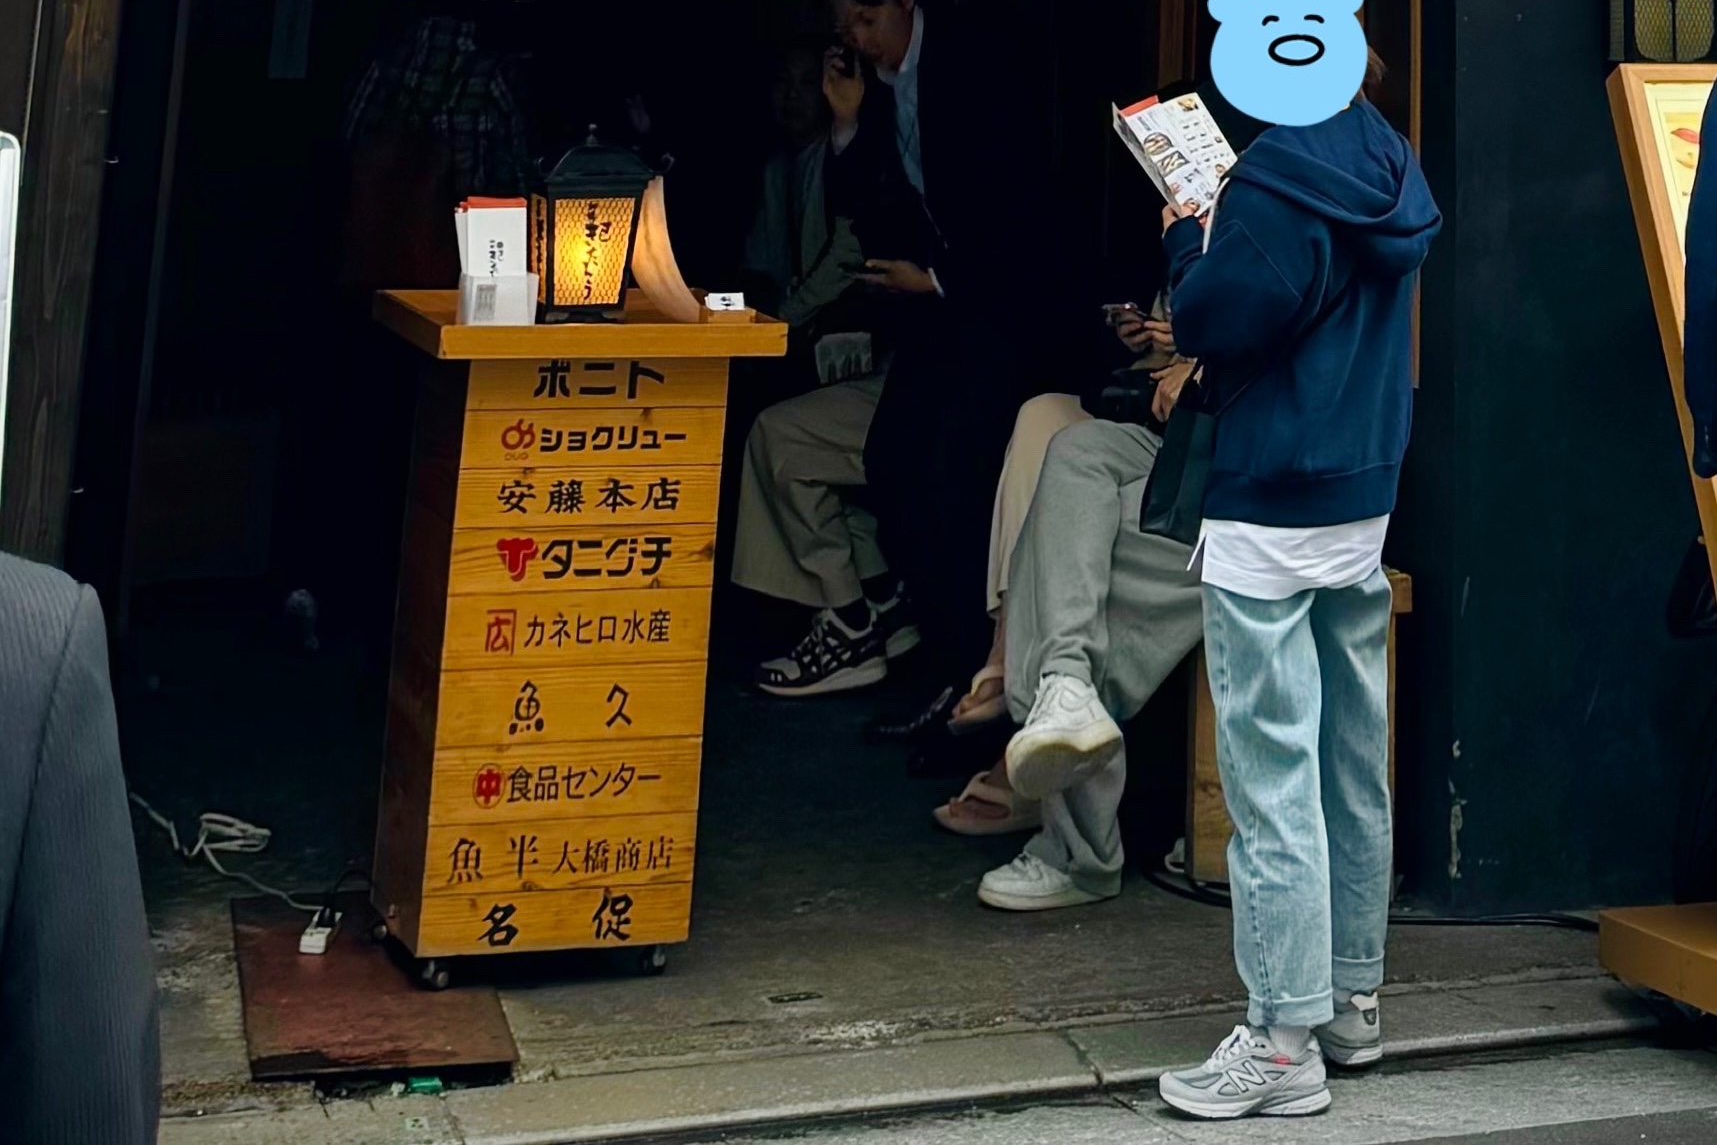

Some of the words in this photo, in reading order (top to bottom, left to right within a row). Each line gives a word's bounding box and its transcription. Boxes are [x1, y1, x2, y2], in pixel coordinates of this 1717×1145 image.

[540, 425, 687, 453] ショクリュー
[497, 477, 682, 514] 安藤本店
[541, 537, 672, 580] タニグチ
[523, 608, 672, 648] カネヒロ水産
[507, 761, 661, 804] 食品センター
[553, 835, 674, 874] 大橋商店
[1228, 1060, 1266, 1092] N
